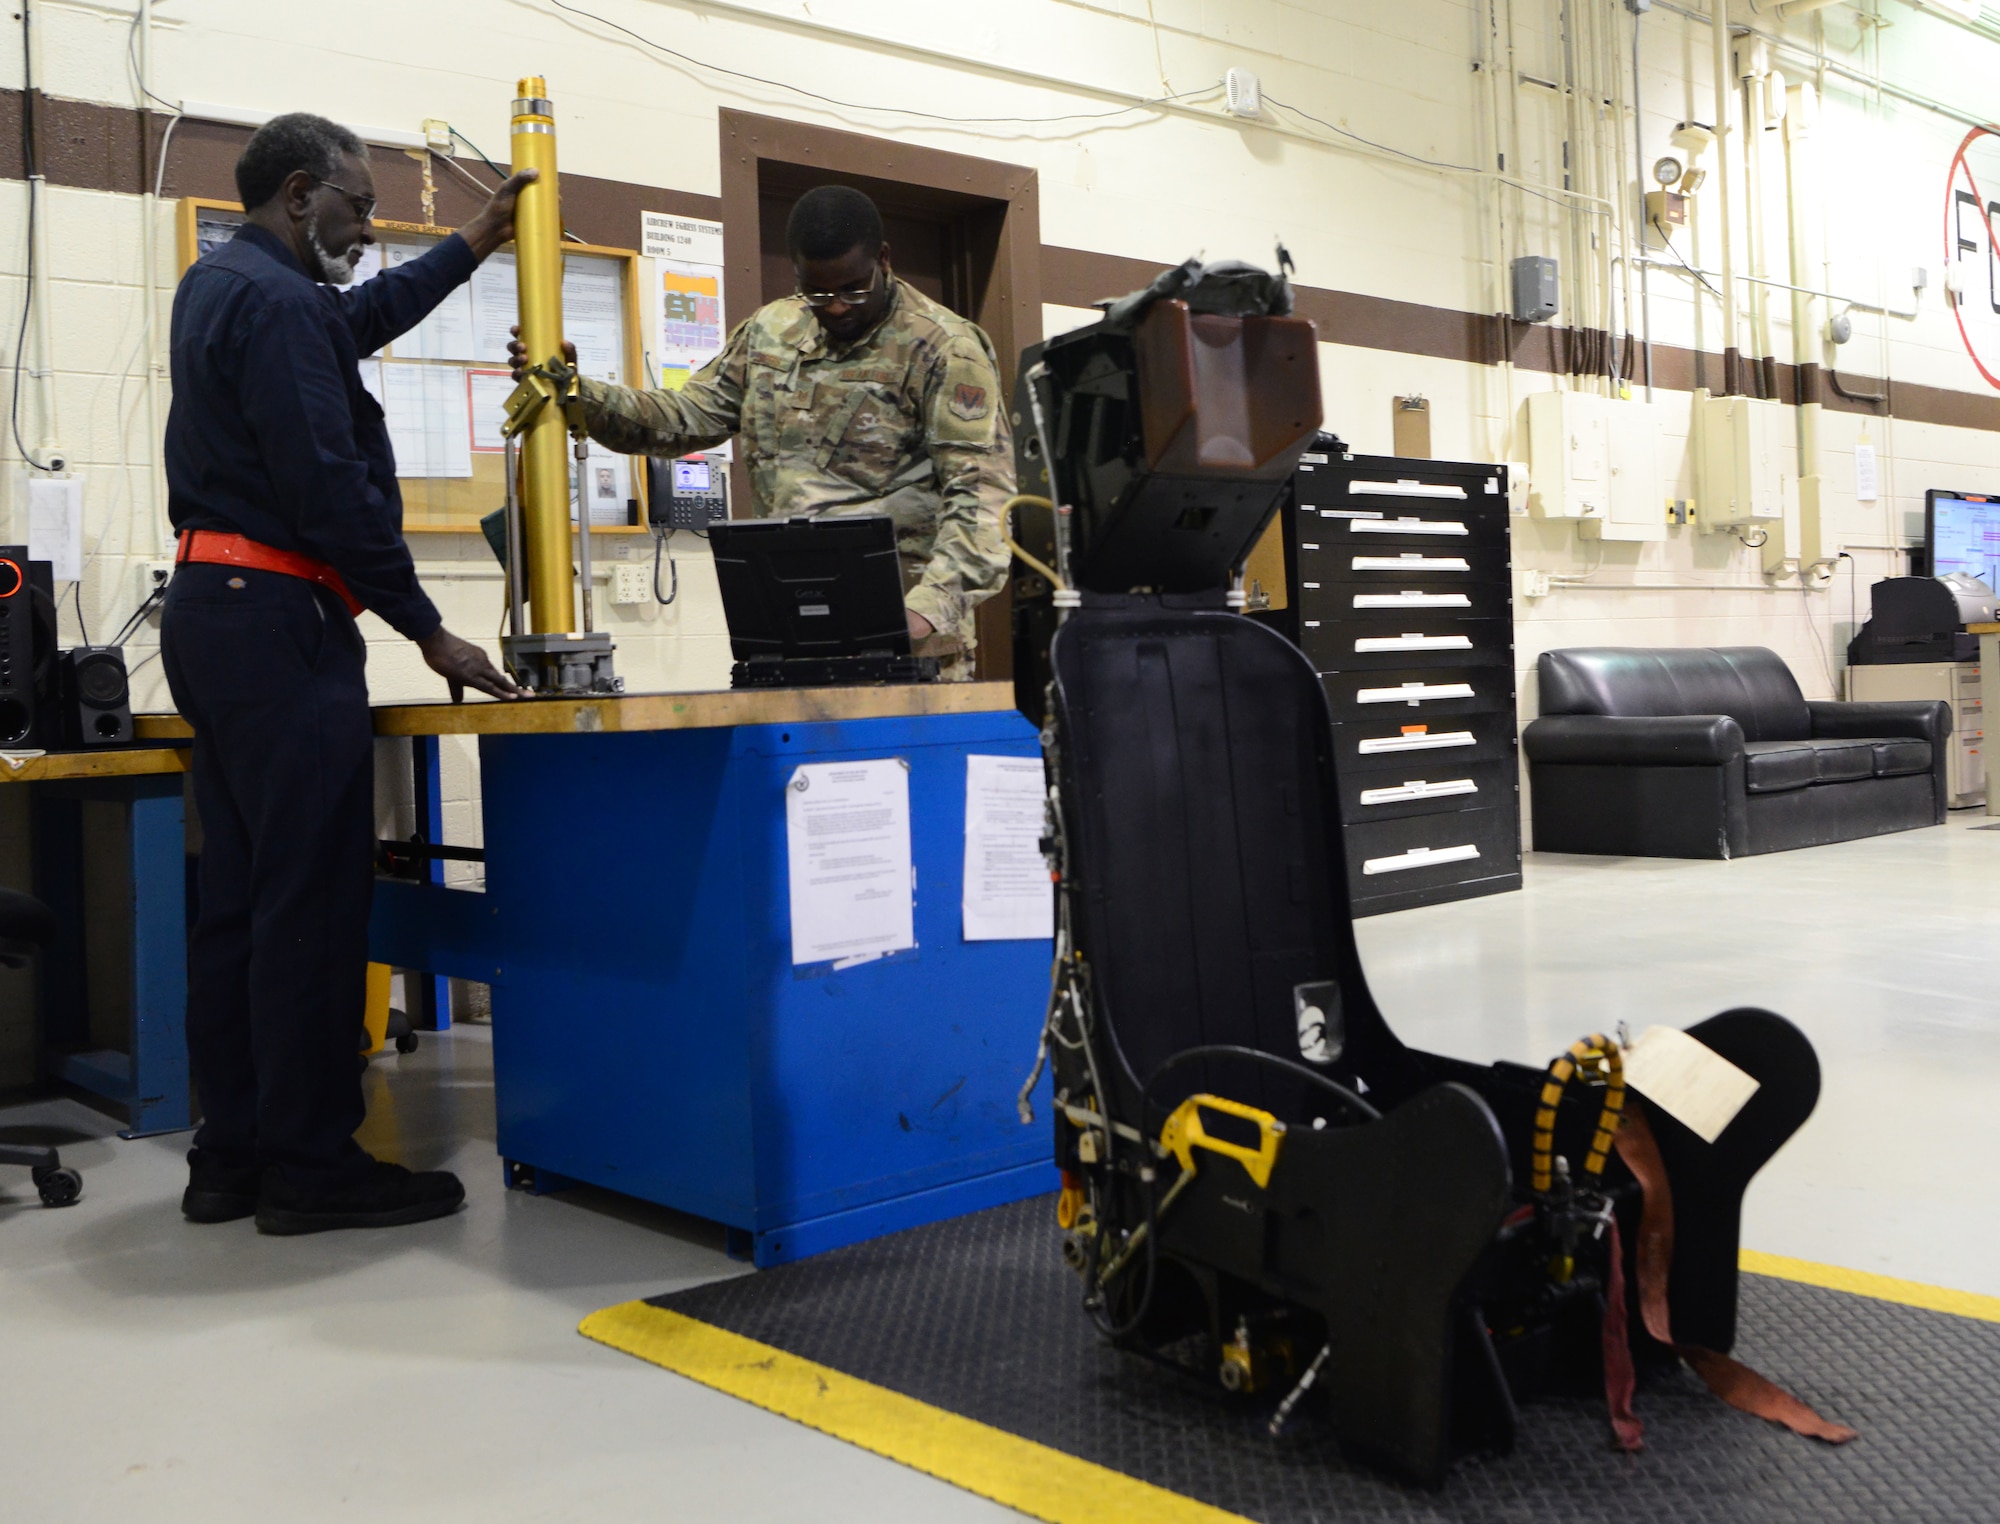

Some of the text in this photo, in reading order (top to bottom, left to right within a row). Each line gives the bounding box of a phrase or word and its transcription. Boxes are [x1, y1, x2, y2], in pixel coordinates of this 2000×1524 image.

[385, 221, 420, 232] WEAPONS
[646, 217, 723, 236] AIRCREW EGRESS SYSTEMS
[646, 231, 692, 245] BUILDING 1240
[646, 245, 666, 255] ROOM
